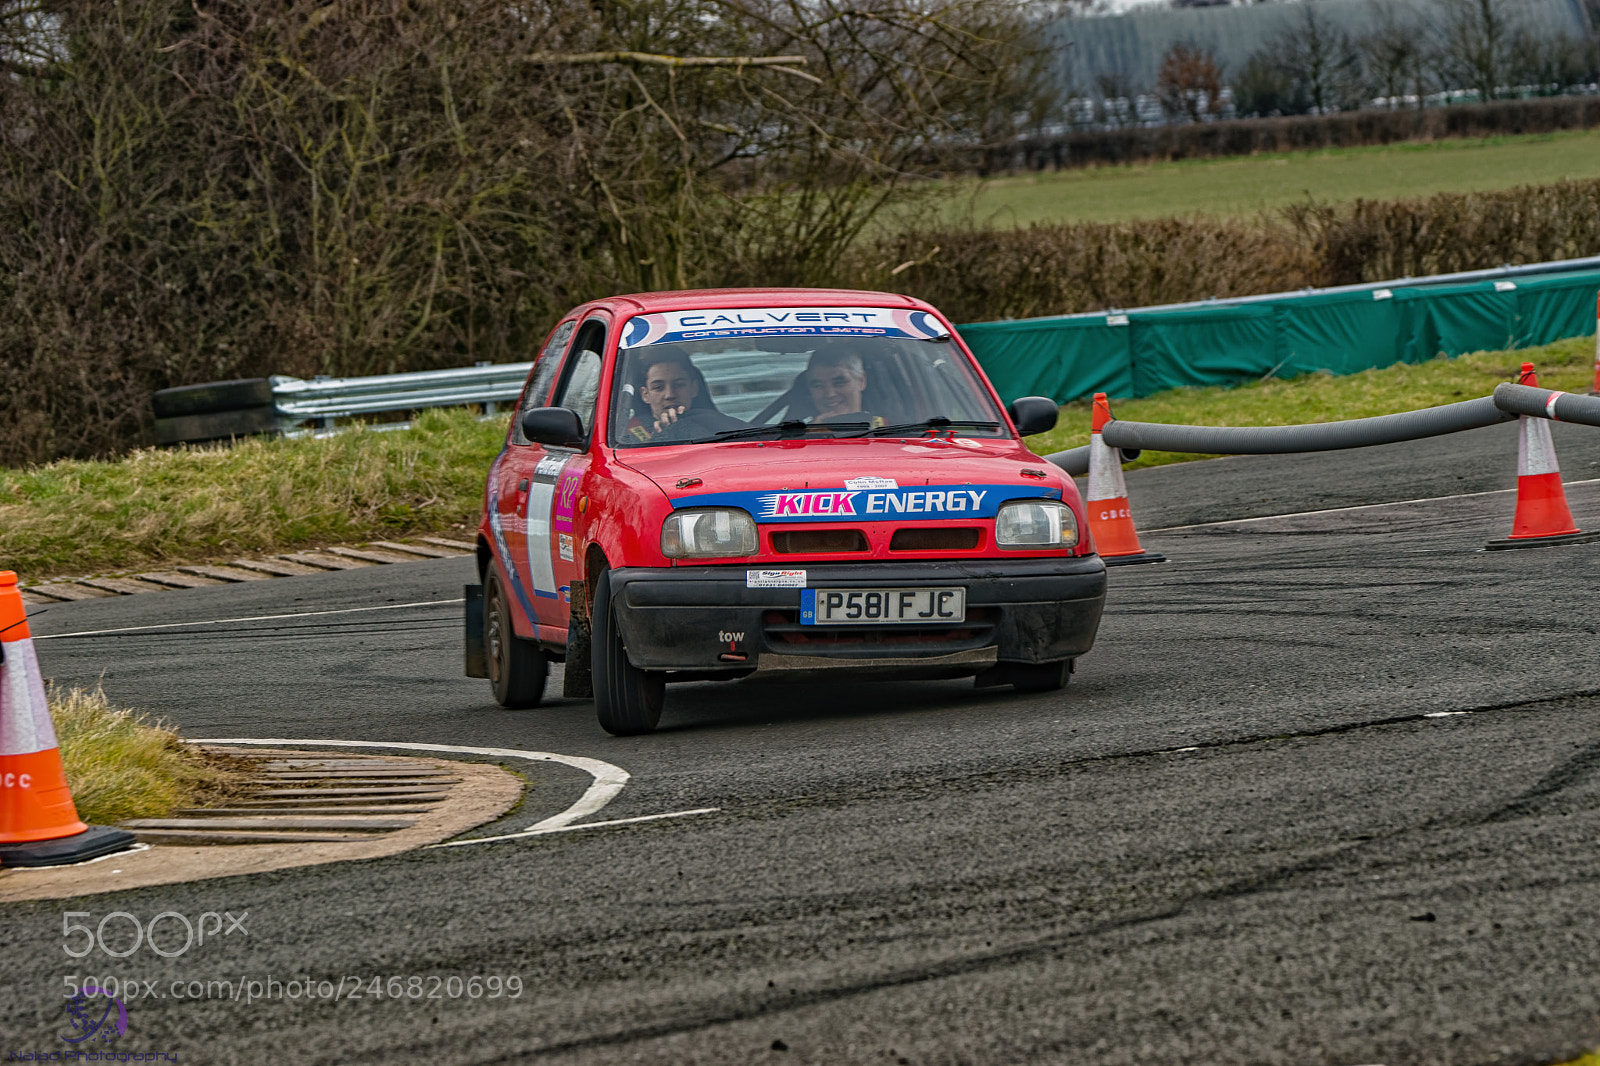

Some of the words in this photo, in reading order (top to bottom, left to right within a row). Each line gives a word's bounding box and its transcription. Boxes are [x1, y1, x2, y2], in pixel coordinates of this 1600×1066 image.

[680, 312, 877, 327] CALVERT
[682, 327, 817, 338] CONSTRUCTION
[772, 491, 861, 517] KICK
[866, 490, 988, 514] ENERGY
[826, 592, 890, 619] P581
[899, 591, 955, 618] FJC
[718, 630, 745, 643] tow
